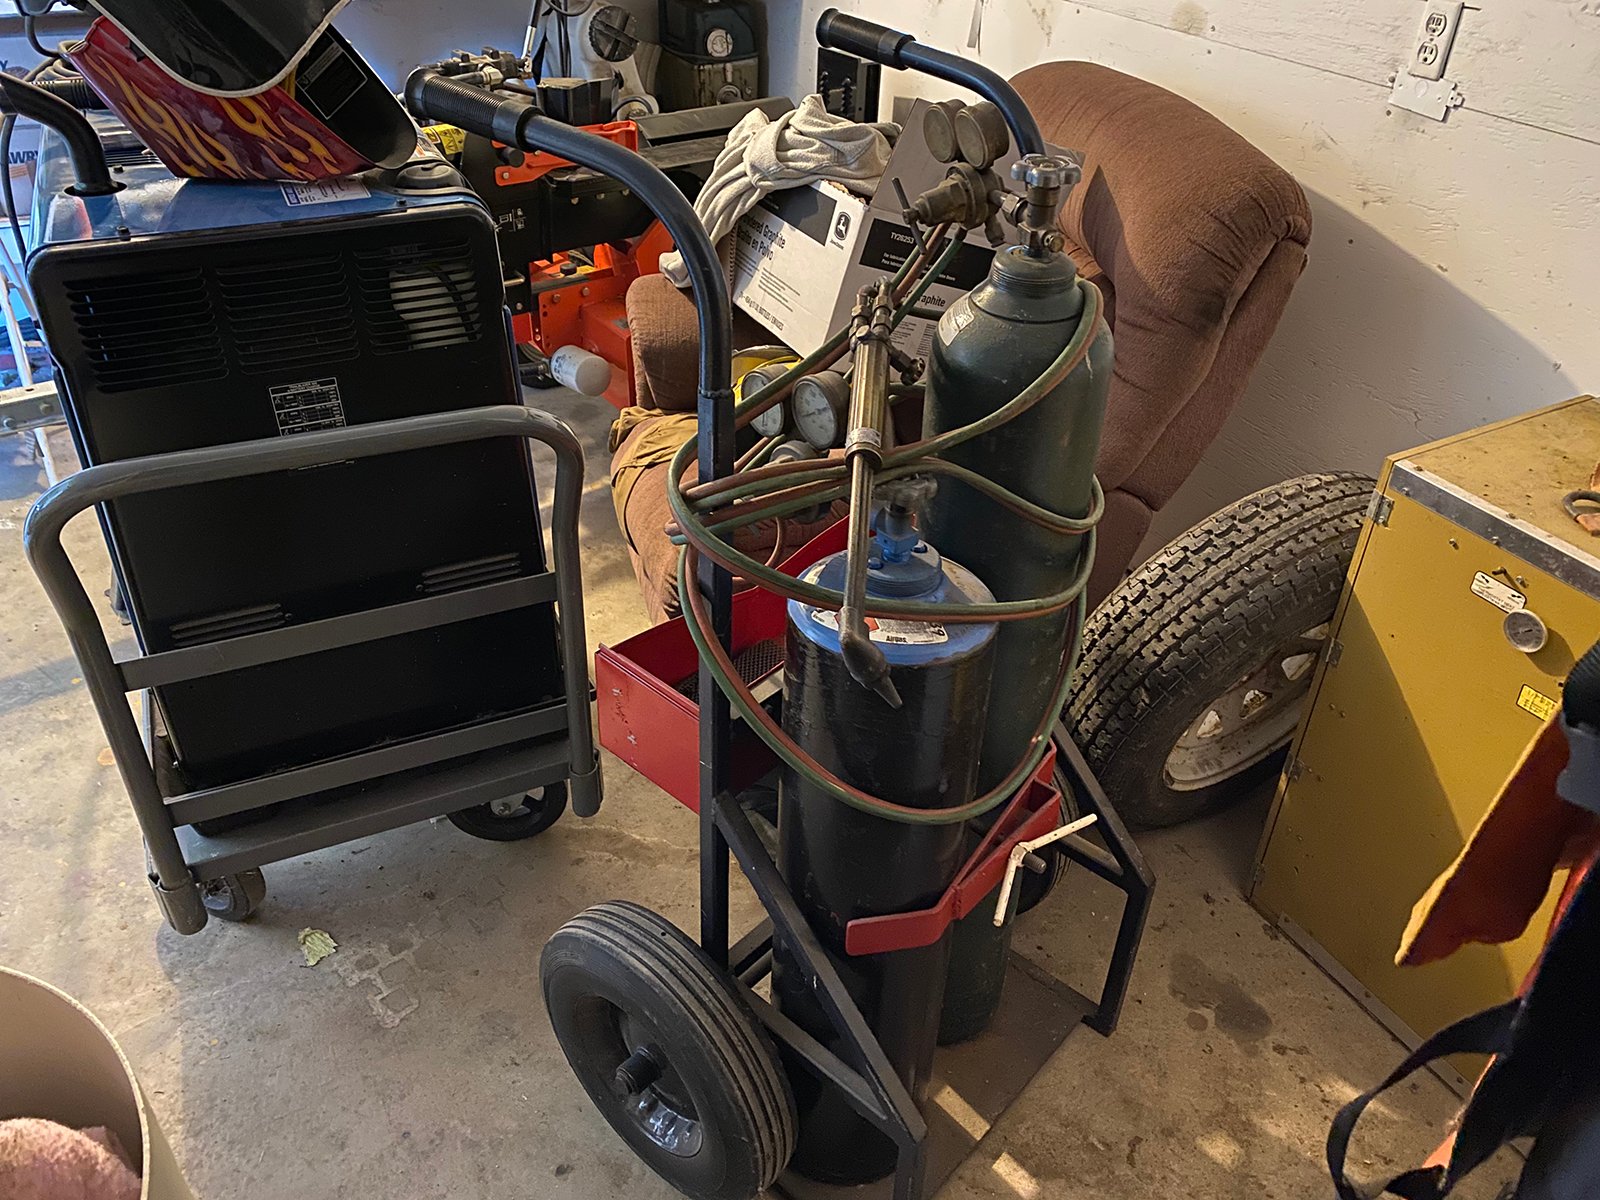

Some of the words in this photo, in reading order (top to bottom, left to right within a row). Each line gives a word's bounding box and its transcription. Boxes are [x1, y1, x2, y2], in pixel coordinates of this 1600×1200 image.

[763, 224, 785, 249] Graphite
[751, 238, 759, 251] en
[758, 240, 774, 261] Polvo
[920, 294, 946, 308] aphite
